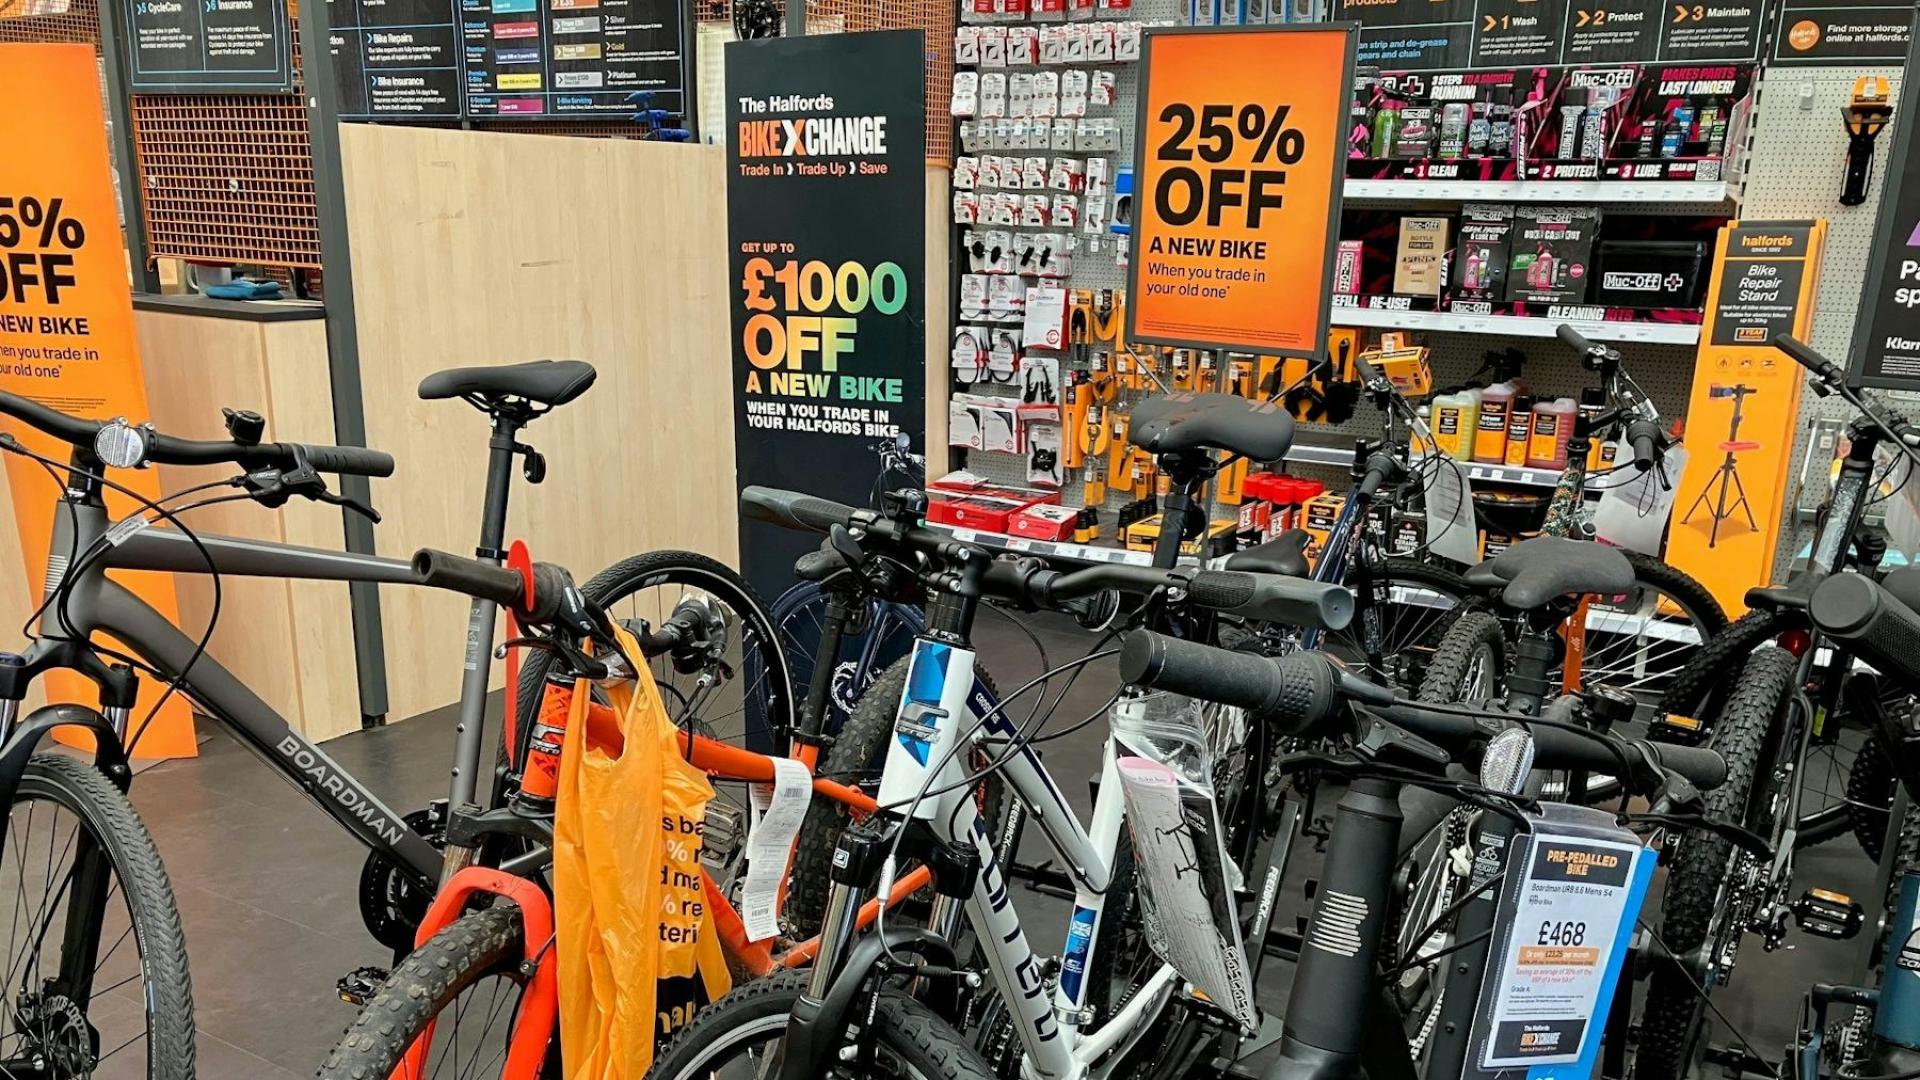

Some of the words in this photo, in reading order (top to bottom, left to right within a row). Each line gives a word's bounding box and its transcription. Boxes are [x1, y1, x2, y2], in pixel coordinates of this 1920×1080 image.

[148, 2, 182, 13] CycleCare
[218, 0, 253, 10] Insurance
[1593, 10, 1605, 25] 2
[1607, 12, 1643, 22] Protect
[1692, 5, 1703, 21] 3
[1707, 7, 1750, 17] Maintain
[1501, 15, 1510, 29] 1
[1512, 16, 1537, 26] Wash
[1874, 25, 1908, 34] storage
[373, 33, 388, 43] Bike
[388, 33, 413, 44] Repairs
[1369, 41, 1387, 50] strip
[1389, 40, 1405, 48] and
[1406, 39, 1448, 48] de-grease
[1826, 34, 1852, 42] online
[1358, 51, 1379, 60] gears
[1398, 50, 1421, 58] chain
[612, 71, 636, 79] Platinum
[1432, 76, 1440, 85] 3
[1440, 75, 1463, 85] STEPS
[1574, 71, 1632, 87] Muc-Off
[1661, 68, 1700, 80] MAKES
[1700, 67, 1736, 79] PARTS
[378, 77, 391, 86] Bike
[392, 77, 424, 86] Insurance
[1659, 81, 1687, 95] LAST
[1430, 85, 1477, 99] RUNNIN
[739, 97, 766, 113] The
[770, 94, 834, 112] Halfords
[739, 116, 887, 157] BIKEXCHANGE
[1157, 103, 1305, 165] 25%
[740, 163, 770, 176] Trade
[773, 163, 784, 175] In
[797, 162, 827, 175] Trade
[829, 161, 846, 176] Up
[859, 161, 888, 175] Save
[1418, 165, 1424, 177] 1
[1428, 165, 1458, 177] CLEAN
[1543, 165, 1551, 177] 2
[1554, 165, 1597, 177] PROTECT
[1622, 165, 1631, 178] 3
[1633, 164, 1662, 177] LUBE
[1154, 166, 1286, 229] OFF
[1742, 235, 1793, 246] halfords
[741, 243, 760, 253] GET
[763, 243, 777, 253] UP
[781, 243, 795, 253] TO
[1149, 236, 1163, 254] A
[1168, 237, 1215, 256] NEW
[1219, 240, 1266, 260] BIKE
[1148, 262, 1185, 277] When
[1188, 267, 1212, 280] you
[1215, 267, 1250, 282] trade
[1253, 269, 1265, 282] in
[1748, 265, 1776, 276] Bike
[0, 253, 76, 304] FF
[1604, 274, 1661, 290] Muc-Off
[1739, 277, 1782, 289] Repair
[742, 257, 907, 315] £1000
[1146, 283, 1175, 296] your
[1179, 283, 1199, 296] old
[1370, 296, 1411, 309] RE-USE!
[1738, 290, 1779, 302] Stand
[1453, 302, 1490, 313] Muc-Off
[1547, 305, 1605, 320] CLEANING
[39, 317, 90, 335] BIKE
[743, 313, 857, 372] OFF
[18, 347, 40, 359] you
[42, 347, 81, 361] trade
[85, 348, 99, 361] in
[14, 364, 32, 377] old
[745, 371, 762, 394] A
[769, 372, 831, 398] NEW
[839, 376, 903, 402] BIKE
[747, 401, 786, 416] WHEN
[789, 403, 819, 419] YOU
[822, 406, 870, 422] TRADE
[874, 410, 889, 423] IN
[747, 415, 784, 430] YOUR
[786, 418, 862, 436] HALFORDS
[864, 422, 900, 438] BIKE
[277, 735, 403, 846] BOARDMAN
[1003, 797, 1022, 847] FEEDBACK
[667, 840, 688, 861] %
[1547, 850, 1618, 867] PRE-PEDALLED
[1566, 864, 1589, 875] BIKE
[1259, 866, 1279, 918] FEEDBACK
[1532, 884, 1561, 893] Boardman
[1585, 887, 1602, 896] Mens
[682, 900, 702, 917] re
[1538, 921, 1586, 946] £468
